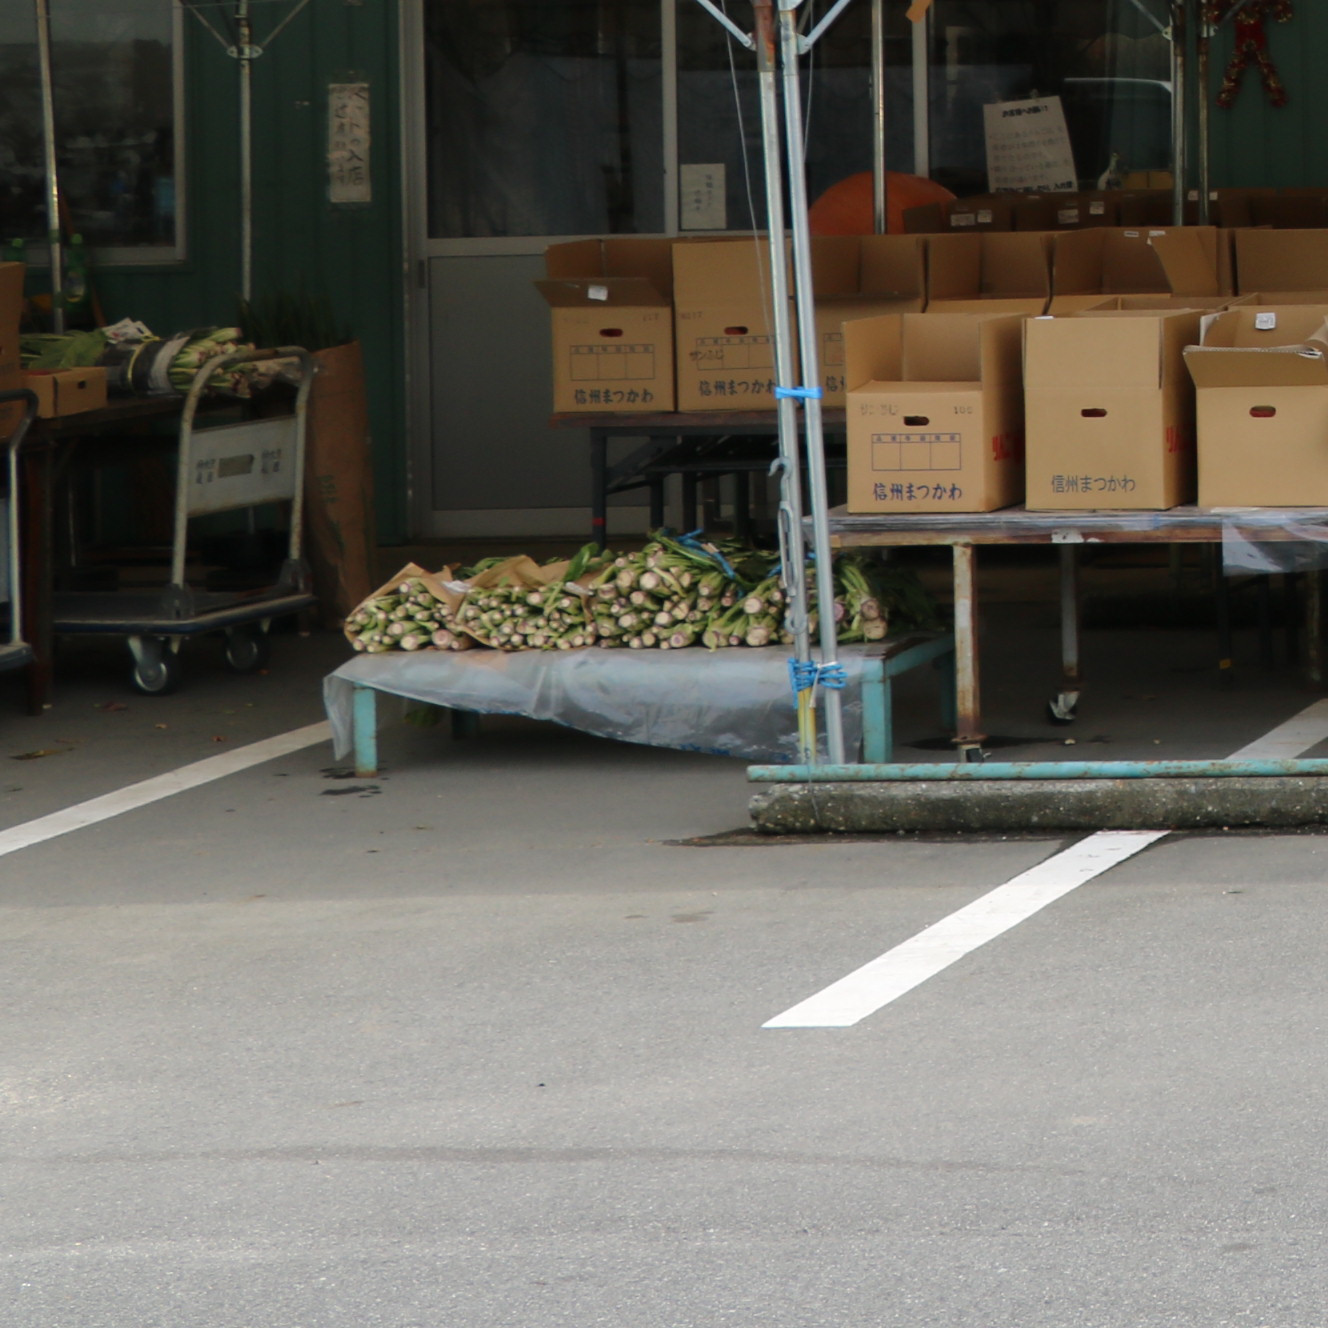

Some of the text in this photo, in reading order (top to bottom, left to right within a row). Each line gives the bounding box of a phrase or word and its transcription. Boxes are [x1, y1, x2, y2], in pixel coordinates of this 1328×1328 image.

[575, 388, 653, 404] 信州まつかわ
[874, 482, 962, 501] 信州まつかわ
[1051, 474, 1136, 493] 信州まつかわ
